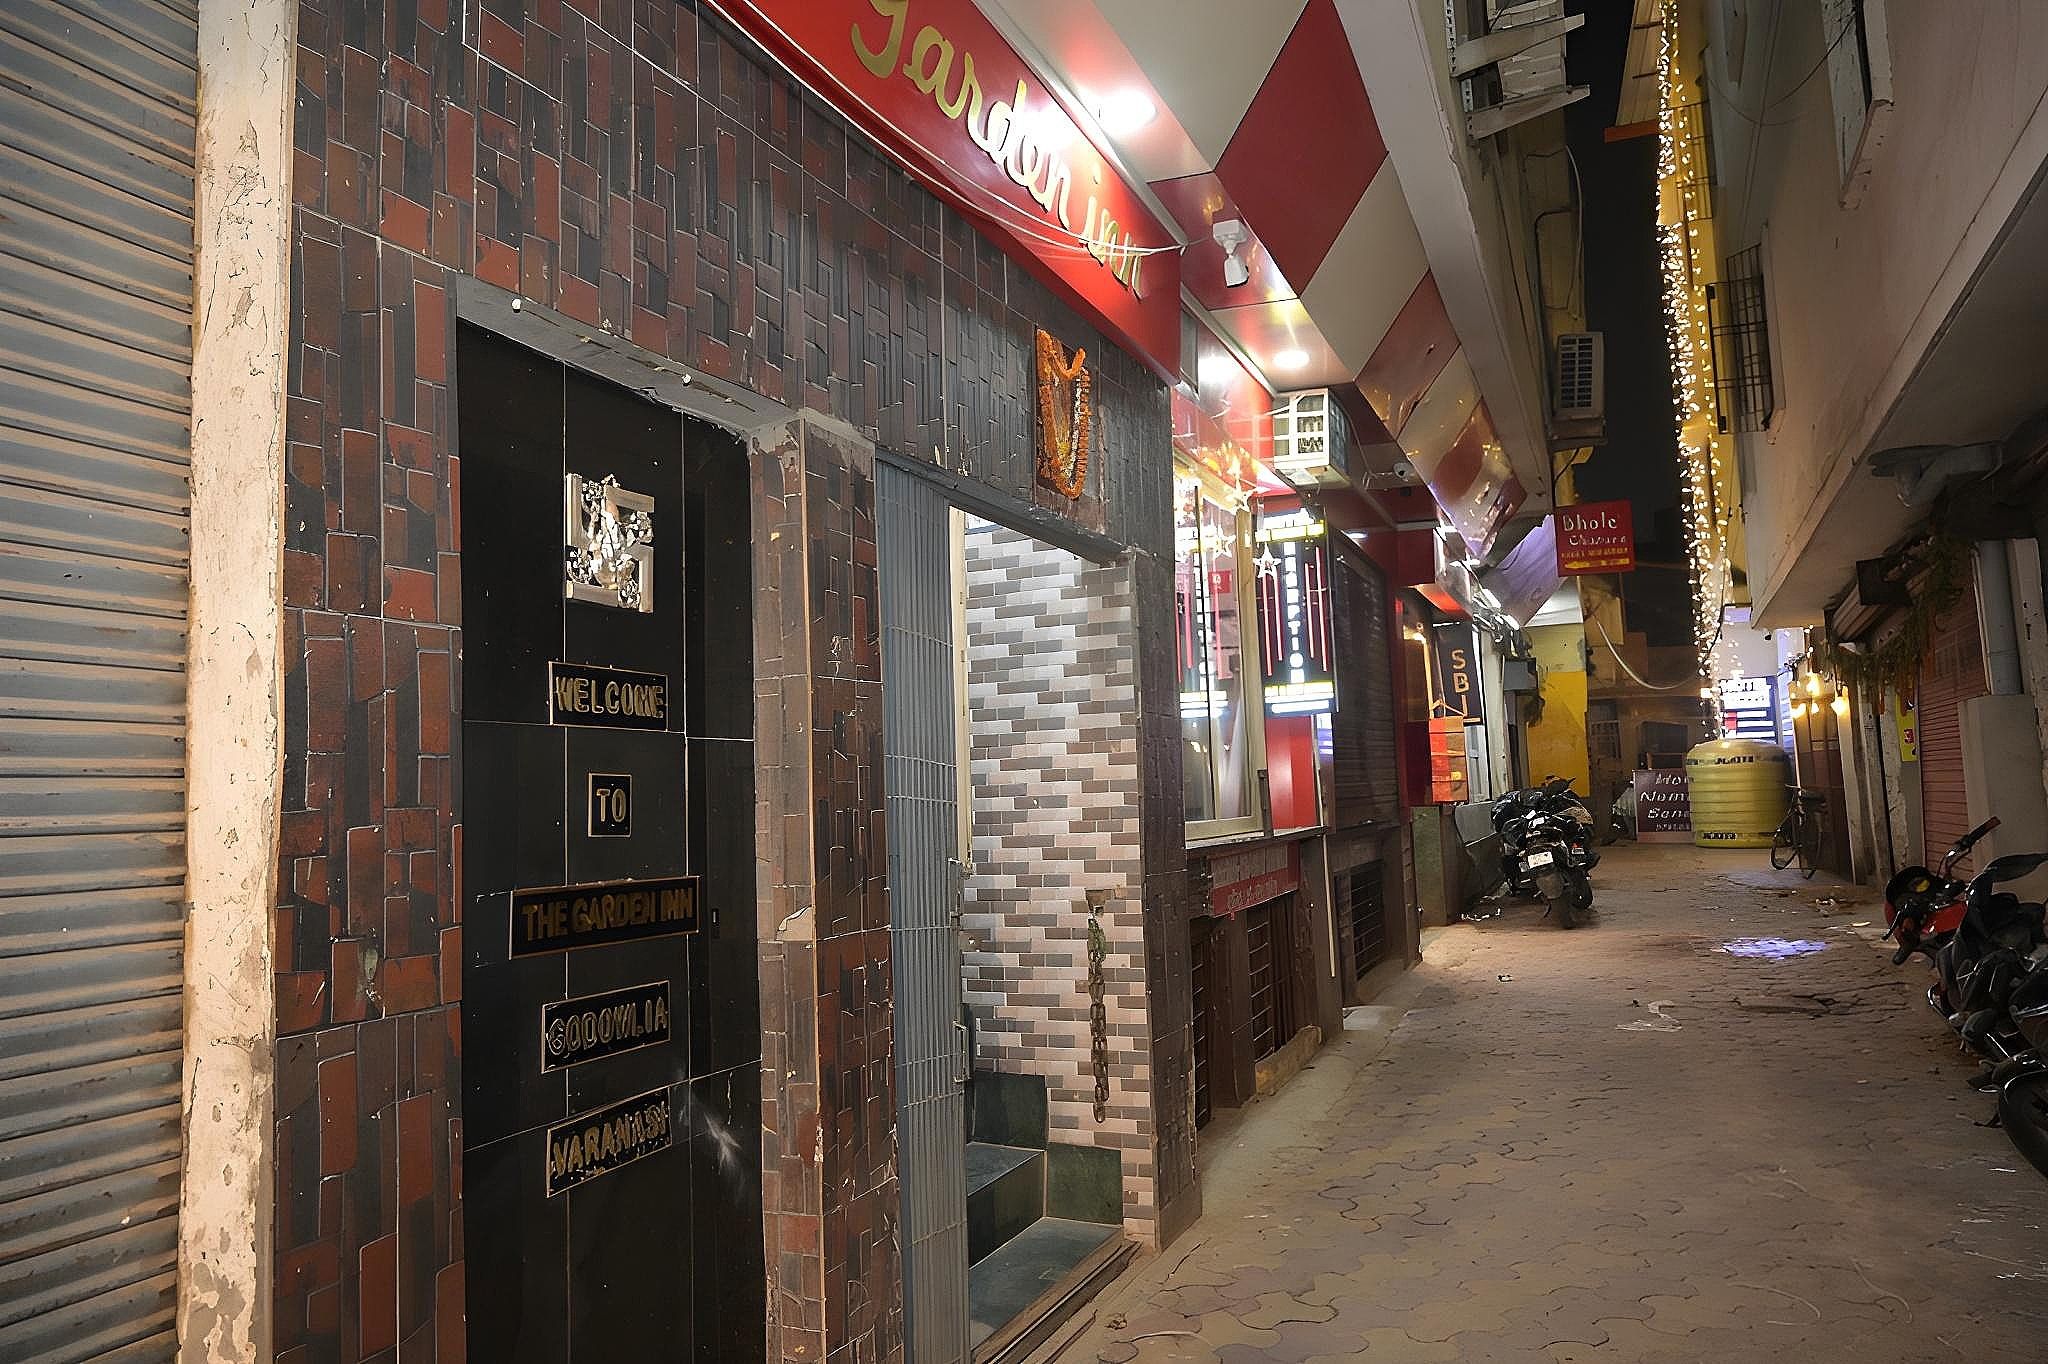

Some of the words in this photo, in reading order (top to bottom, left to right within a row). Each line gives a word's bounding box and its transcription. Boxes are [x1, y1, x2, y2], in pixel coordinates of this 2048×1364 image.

[555, 676, 664, 719] WELCOME
[596, 788, 627, 822] TO
[522, 900, 569, 941] THE
[570, 891, 657, 932] GARDEN
[660, 887, 694, 922] INN
[548, 996, 668, 1056] GODOWLIA
[552, 1100, 667, 1177] VARANASI
